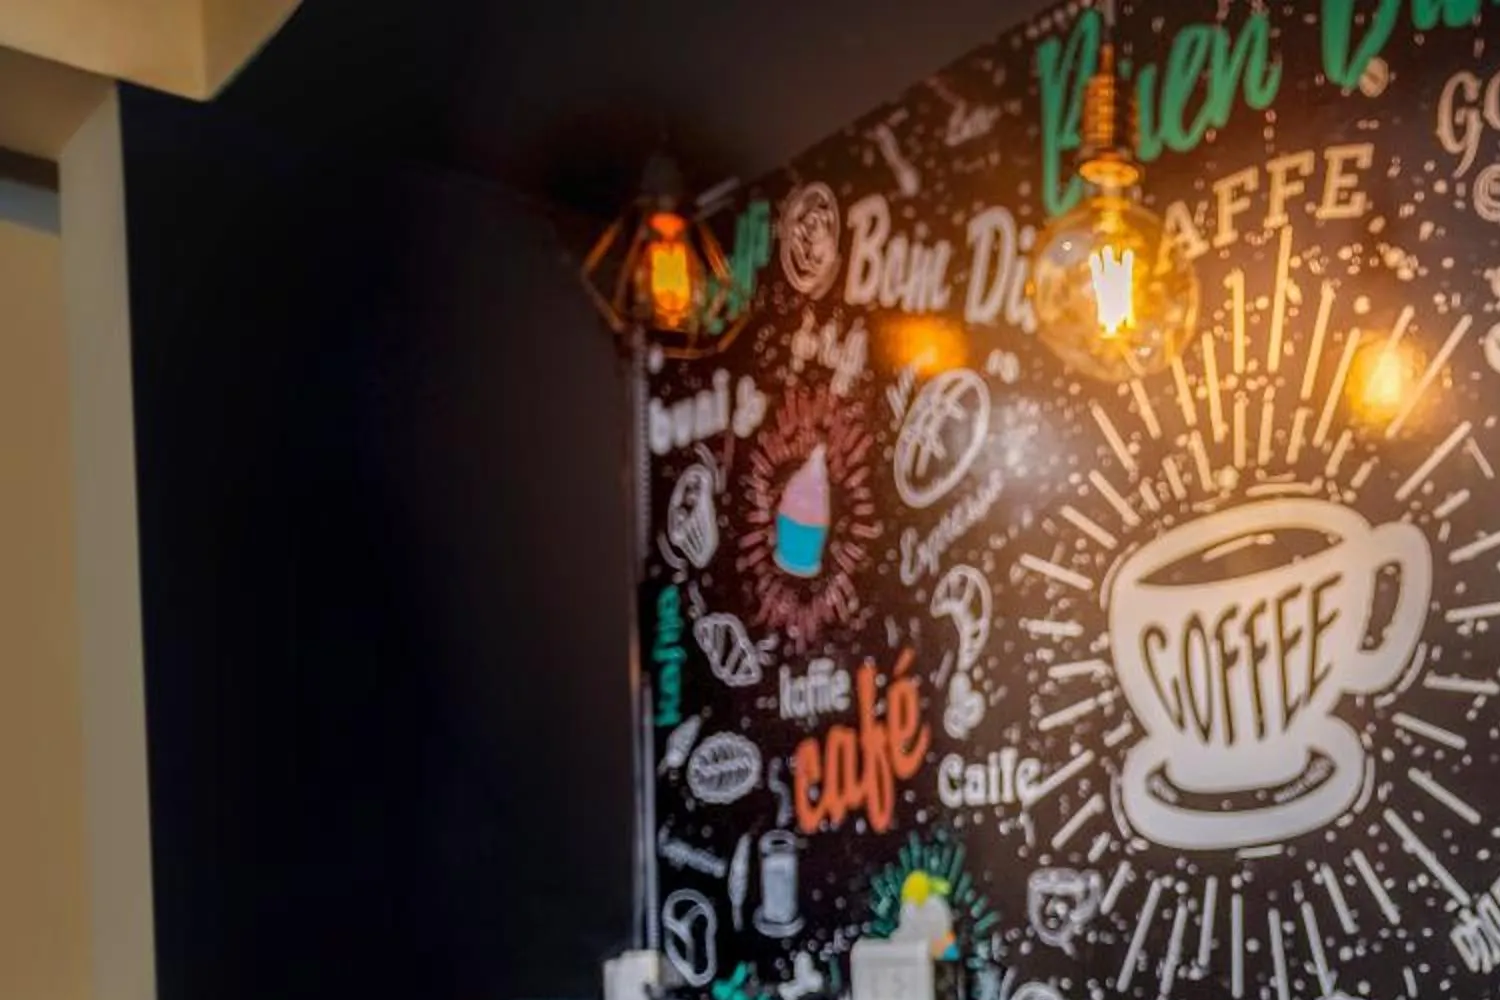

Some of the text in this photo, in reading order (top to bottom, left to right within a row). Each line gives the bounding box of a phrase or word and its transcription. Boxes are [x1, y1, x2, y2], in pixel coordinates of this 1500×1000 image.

[964, 205, 1038, 333] Di
[1153, 142, 1376, 276] AFFE
[1142, 571, 1343, 748] COFFEE
[794, 648, 932, 835] café
